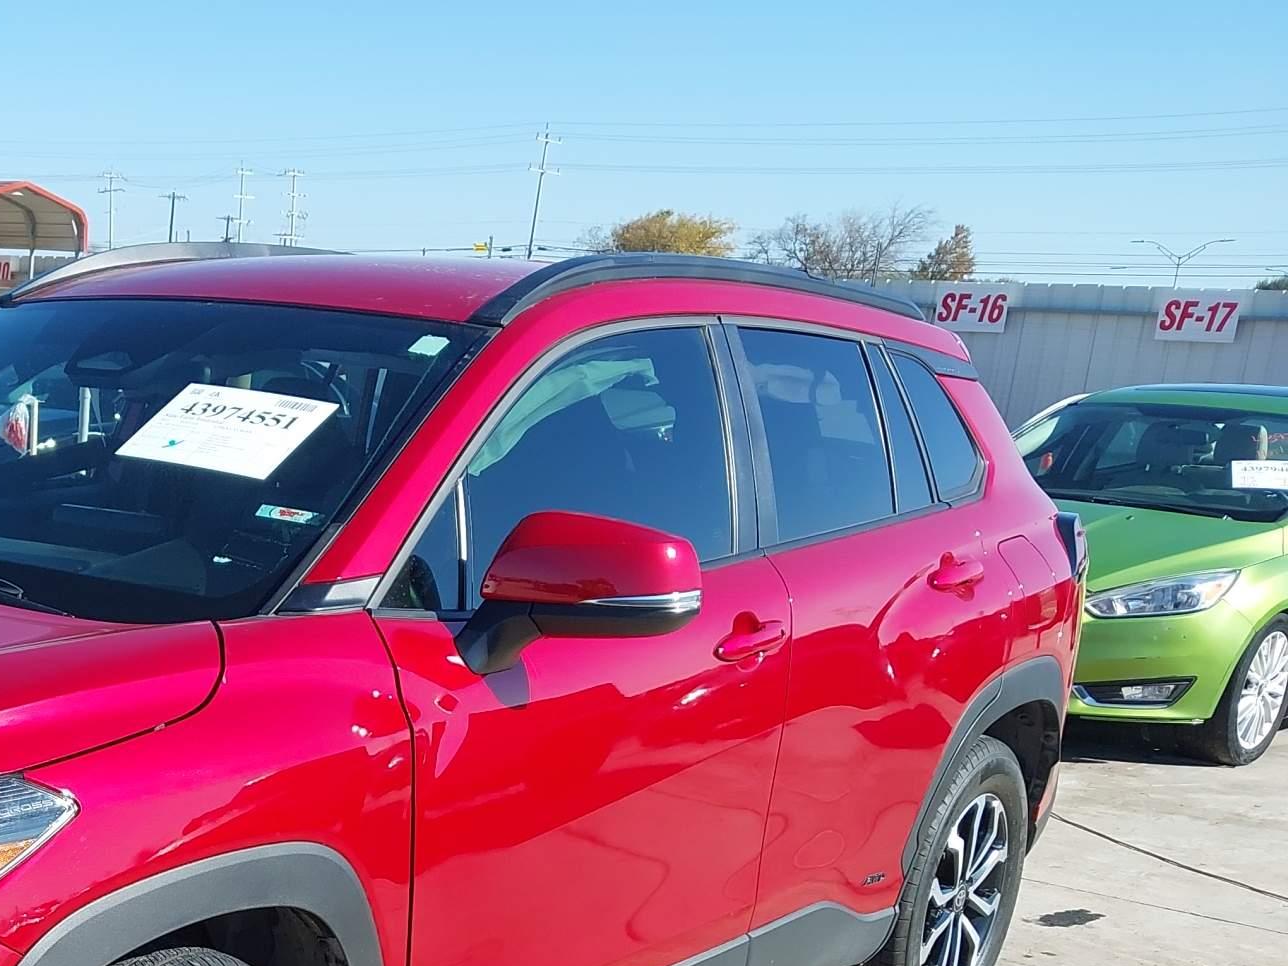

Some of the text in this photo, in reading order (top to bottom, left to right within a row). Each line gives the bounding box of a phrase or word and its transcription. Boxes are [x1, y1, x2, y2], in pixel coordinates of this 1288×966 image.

[937, 292, 1008, 324] SF-16
[1159, 299, 1239, 332] SF-17
[181, 402, 299, 430] 43974551
